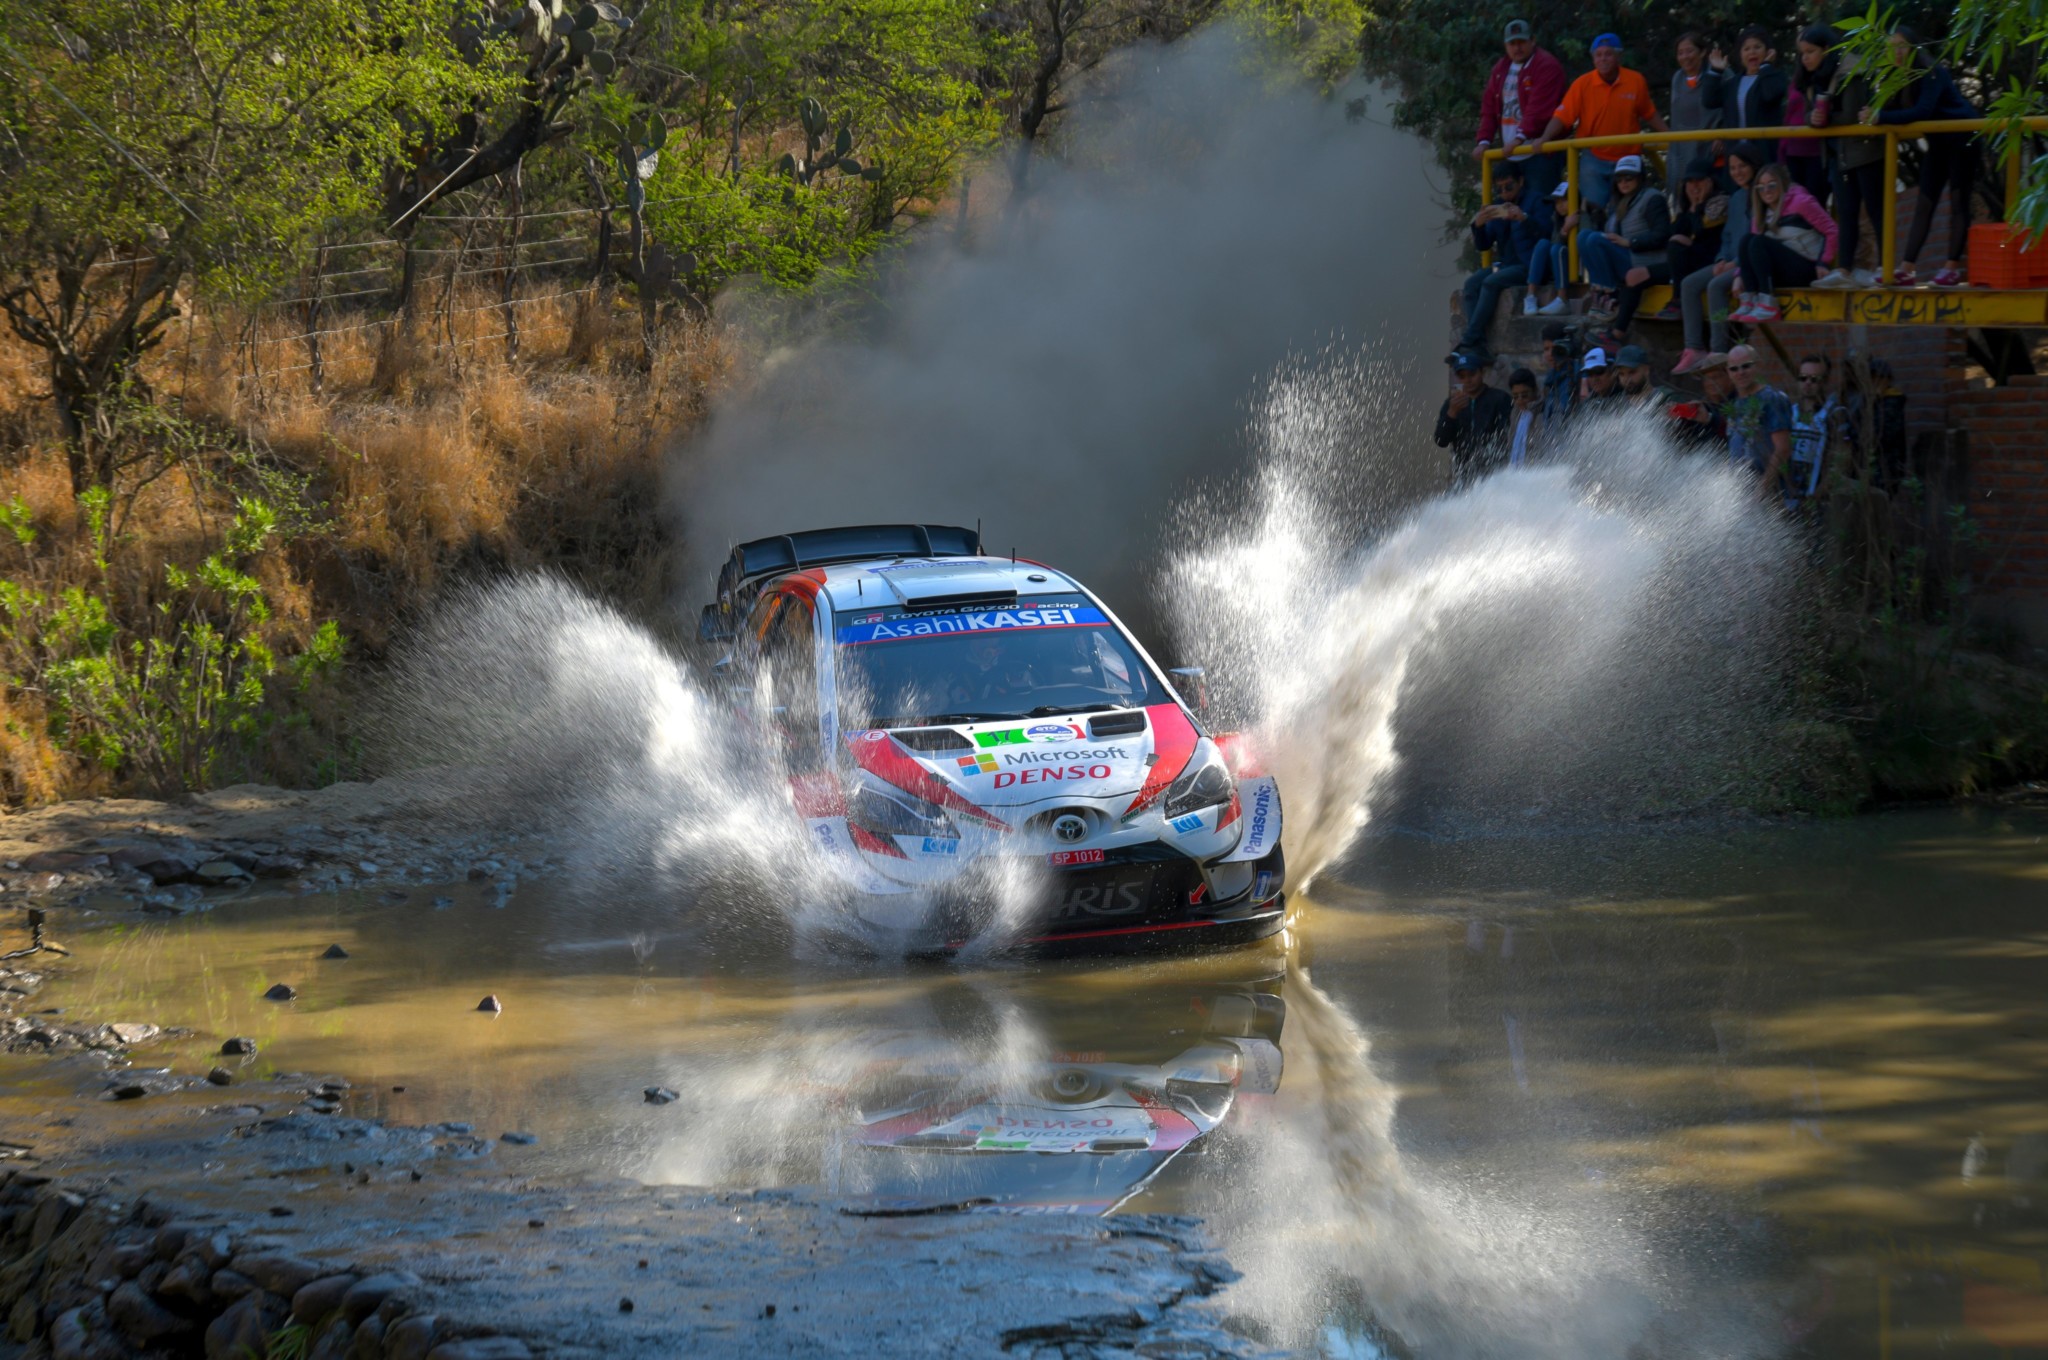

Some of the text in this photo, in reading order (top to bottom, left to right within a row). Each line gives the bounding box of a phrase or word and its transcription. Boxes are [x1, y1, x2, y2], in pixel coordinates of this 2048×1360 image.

[853, 615, 883, 625] GR
[888, 602, 1079, 621] TOYOTA GAZOO Racing
[986, 729, 1011, 743] 17
[1003, 746, 1130, 765] Microsoft
[993, 764, 1112, 790] DENSO
[1243, 785, 1271, 855] Panasonic
[1054, 849, 1102, 864] SP 1012
